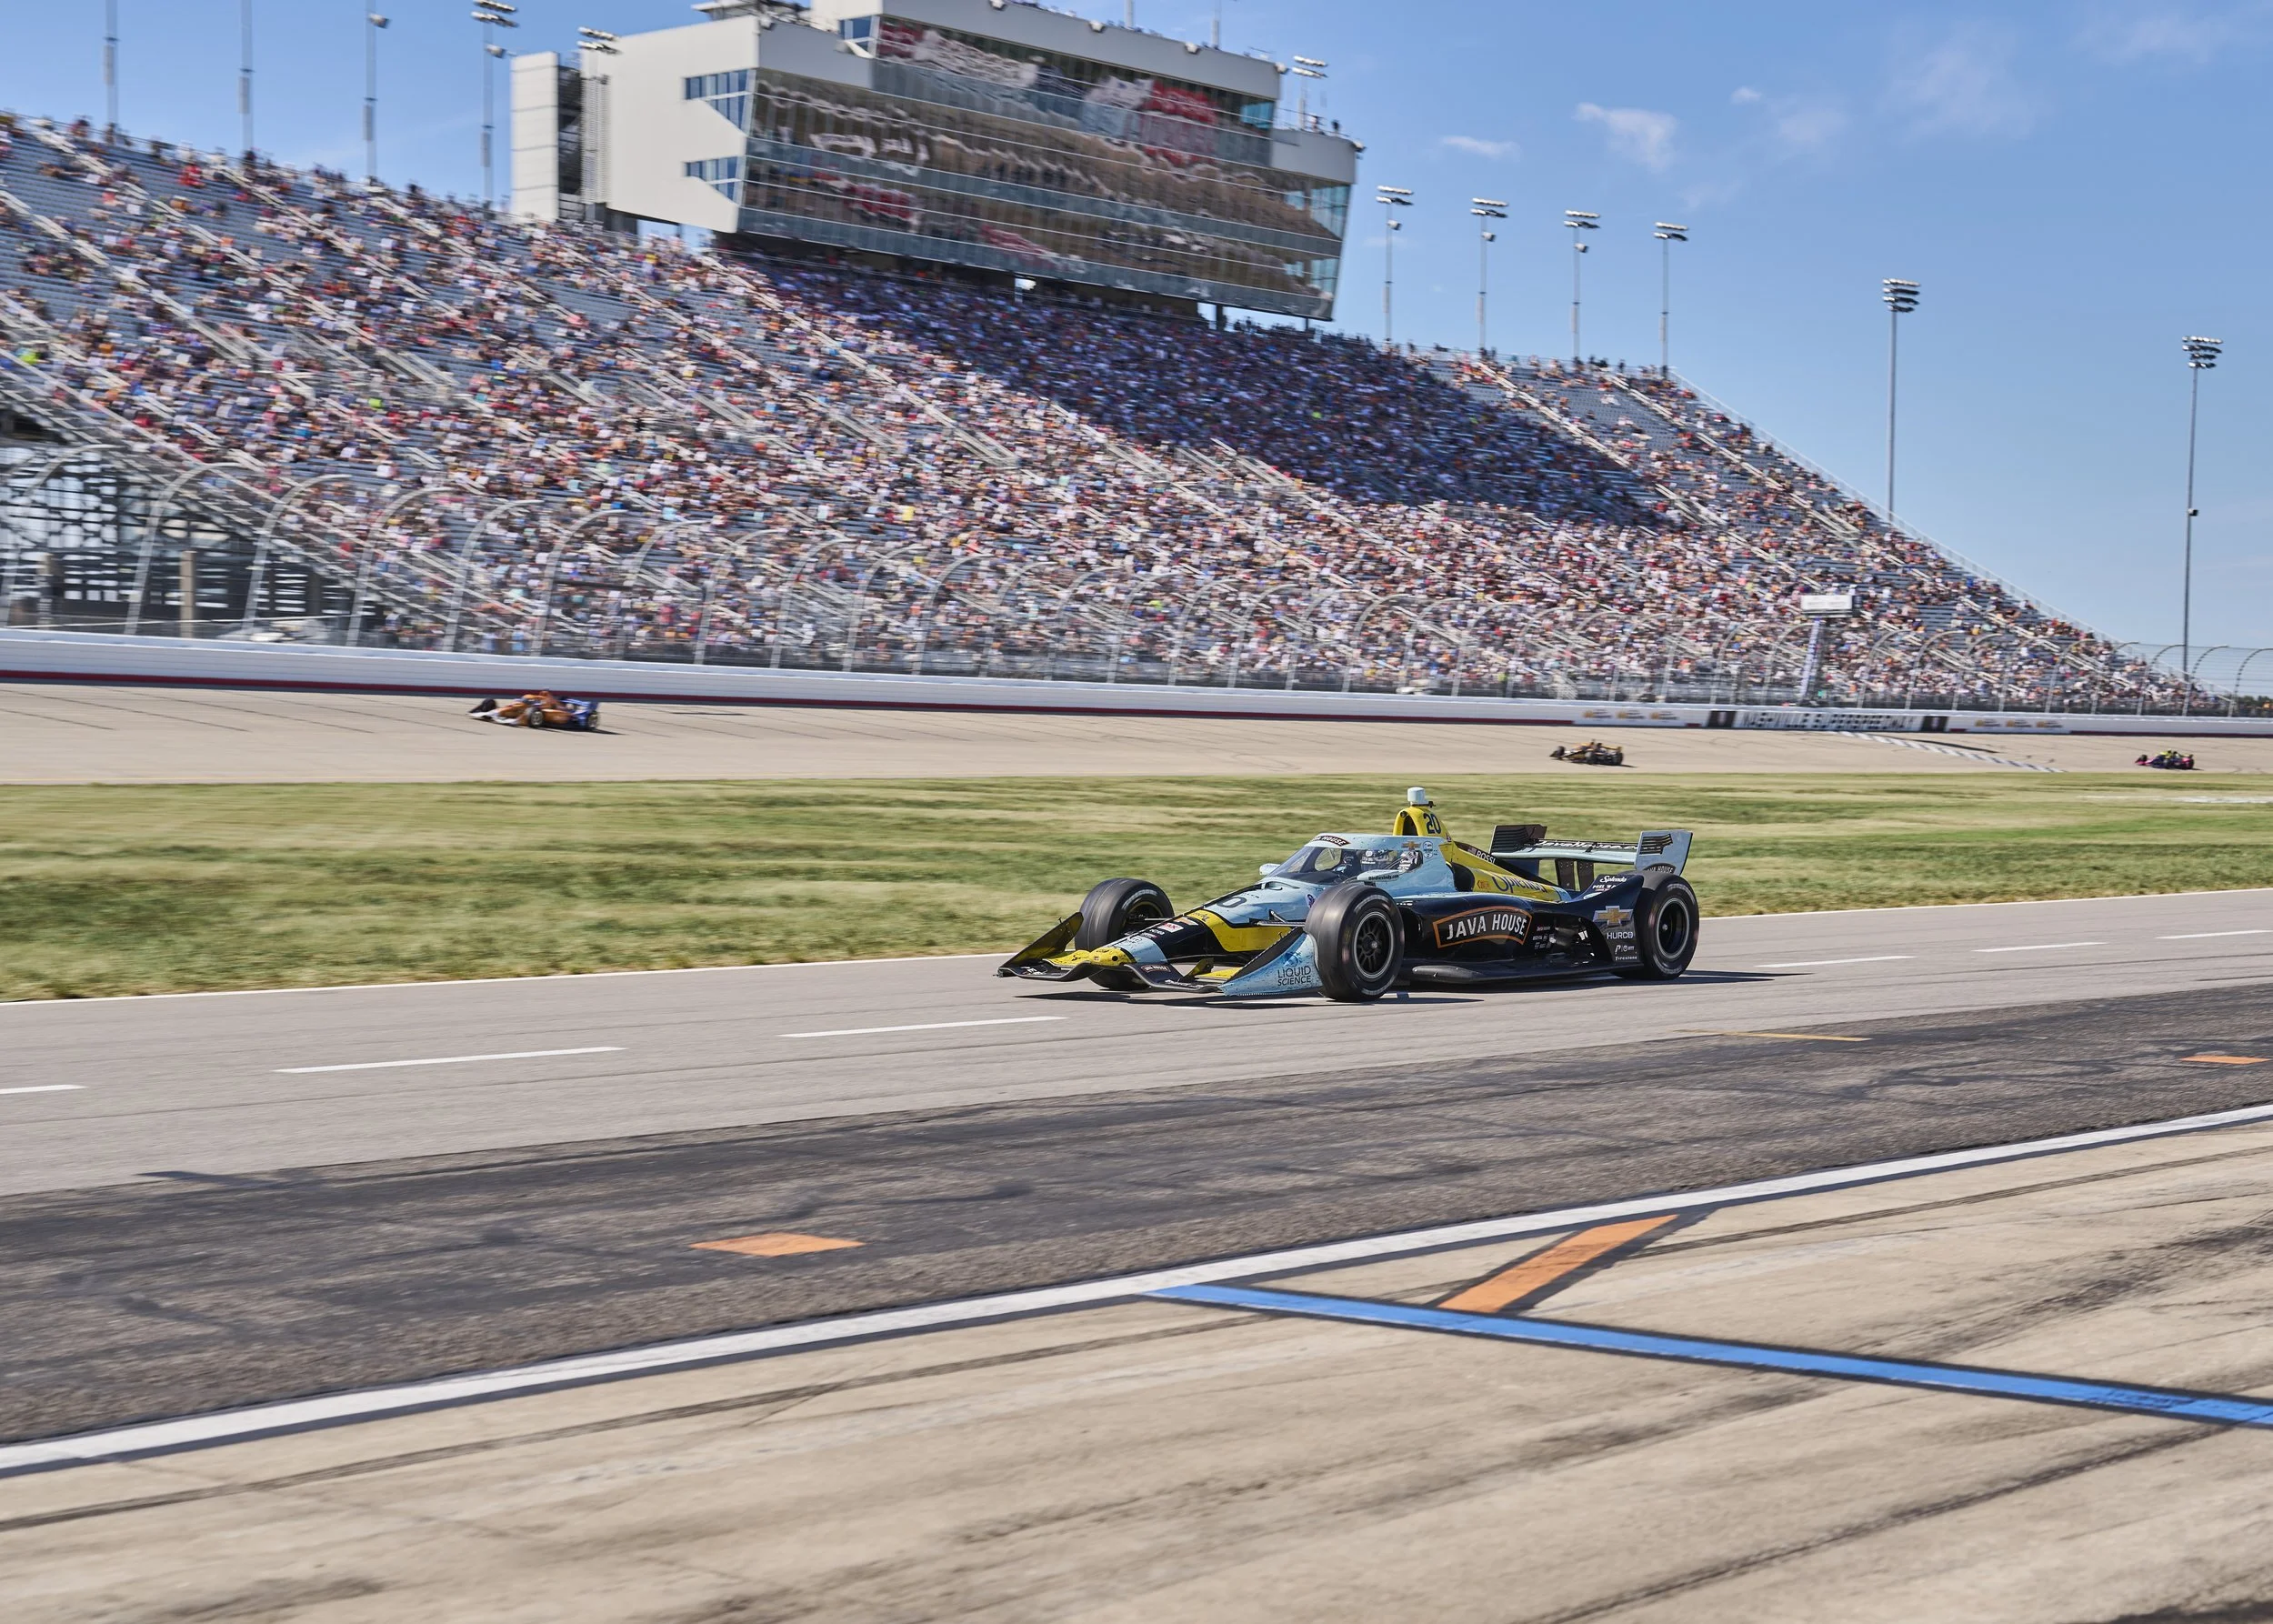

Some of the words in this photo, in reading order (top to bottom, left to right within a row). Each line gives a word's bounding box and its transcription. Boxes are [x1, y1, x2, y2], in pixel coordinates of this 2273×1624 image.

[1423, 813, 1441, 834] 20
[1322, 837, 1346, 846] HOUSE
[1477, 850, 1497, 864] ROSSI
[1447, 916, 1487, 940] JAVA
[1492, 913, 1527, 936] HOUSE
[1277, 965, 1312, 978] LIQUID
[1277, 976, 1312, 987] SCIENCE
